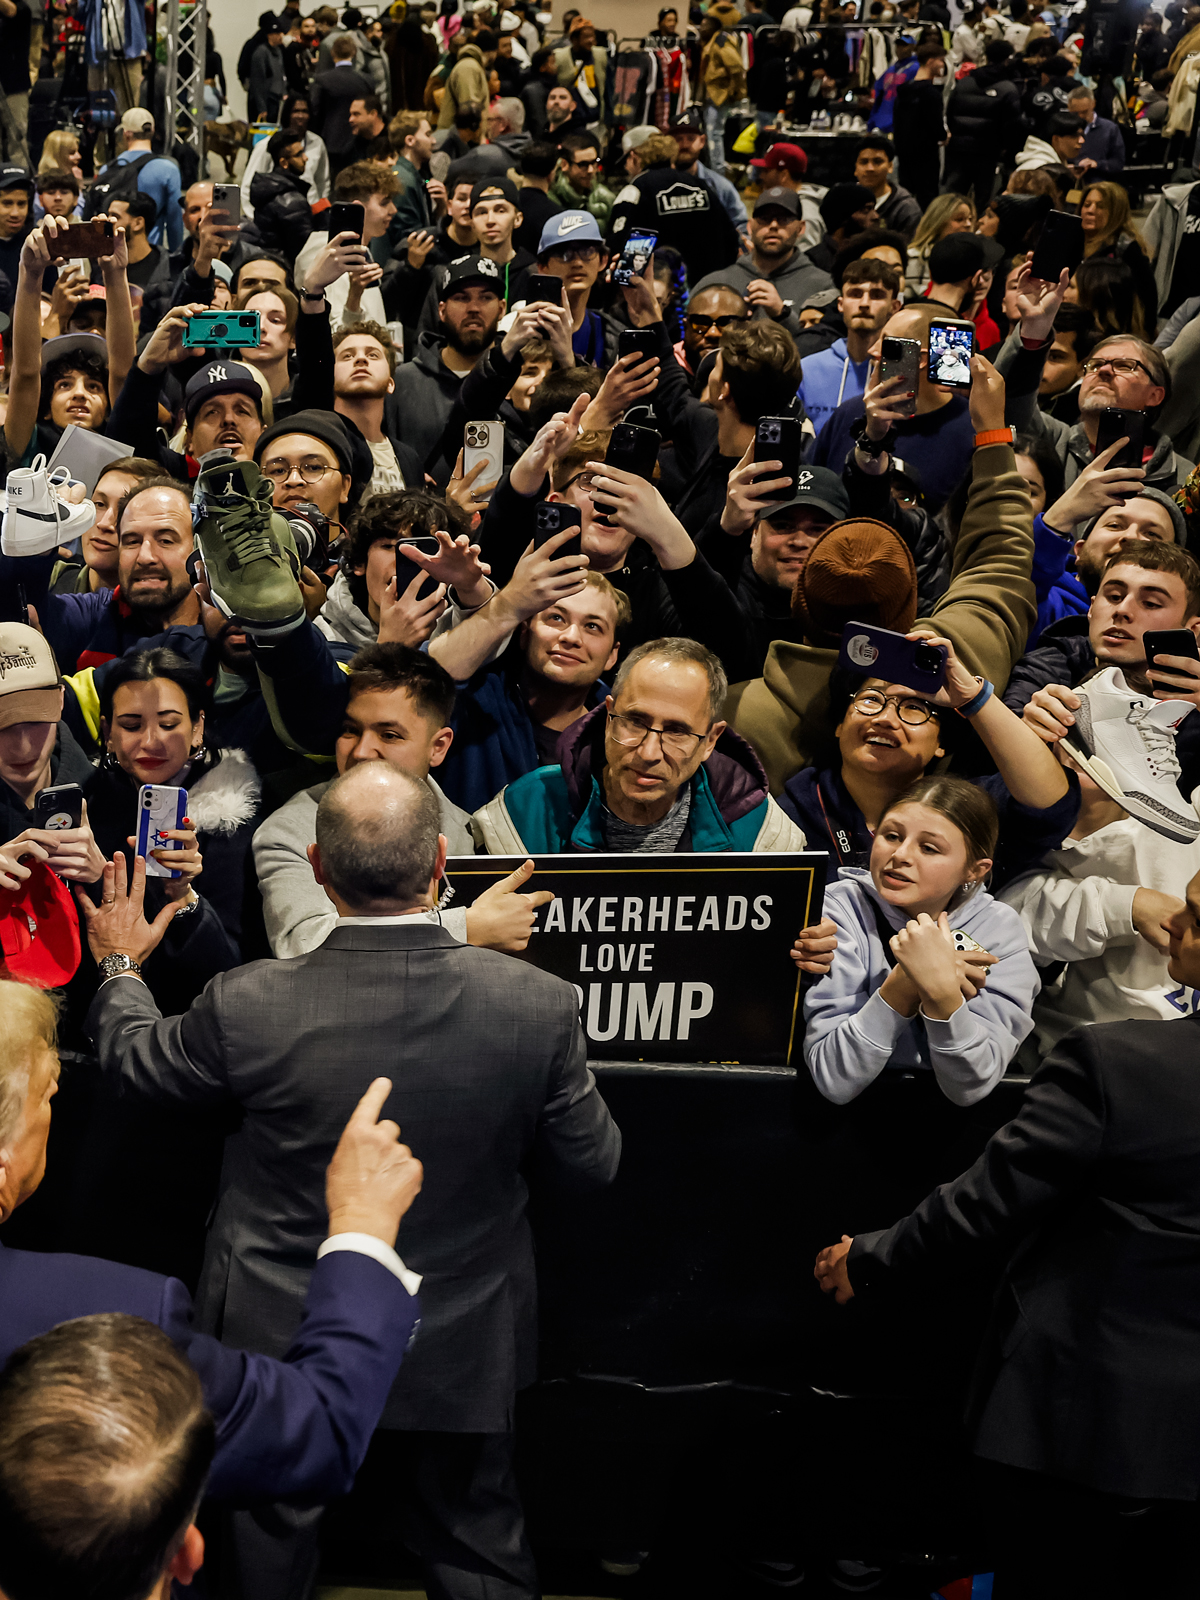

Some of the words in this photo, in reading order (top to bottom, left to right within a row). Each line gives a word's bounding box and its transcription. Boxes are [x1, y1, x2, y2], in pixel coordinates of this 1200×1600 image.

[562, 215, 584, 228] NIKE
[836, 830, 851, 853] EOS
[531, 894, 773, 933] AKERHEADS
[579, 943, 655, 972] LOVE
[575, 981, 714, 1042] UMP
